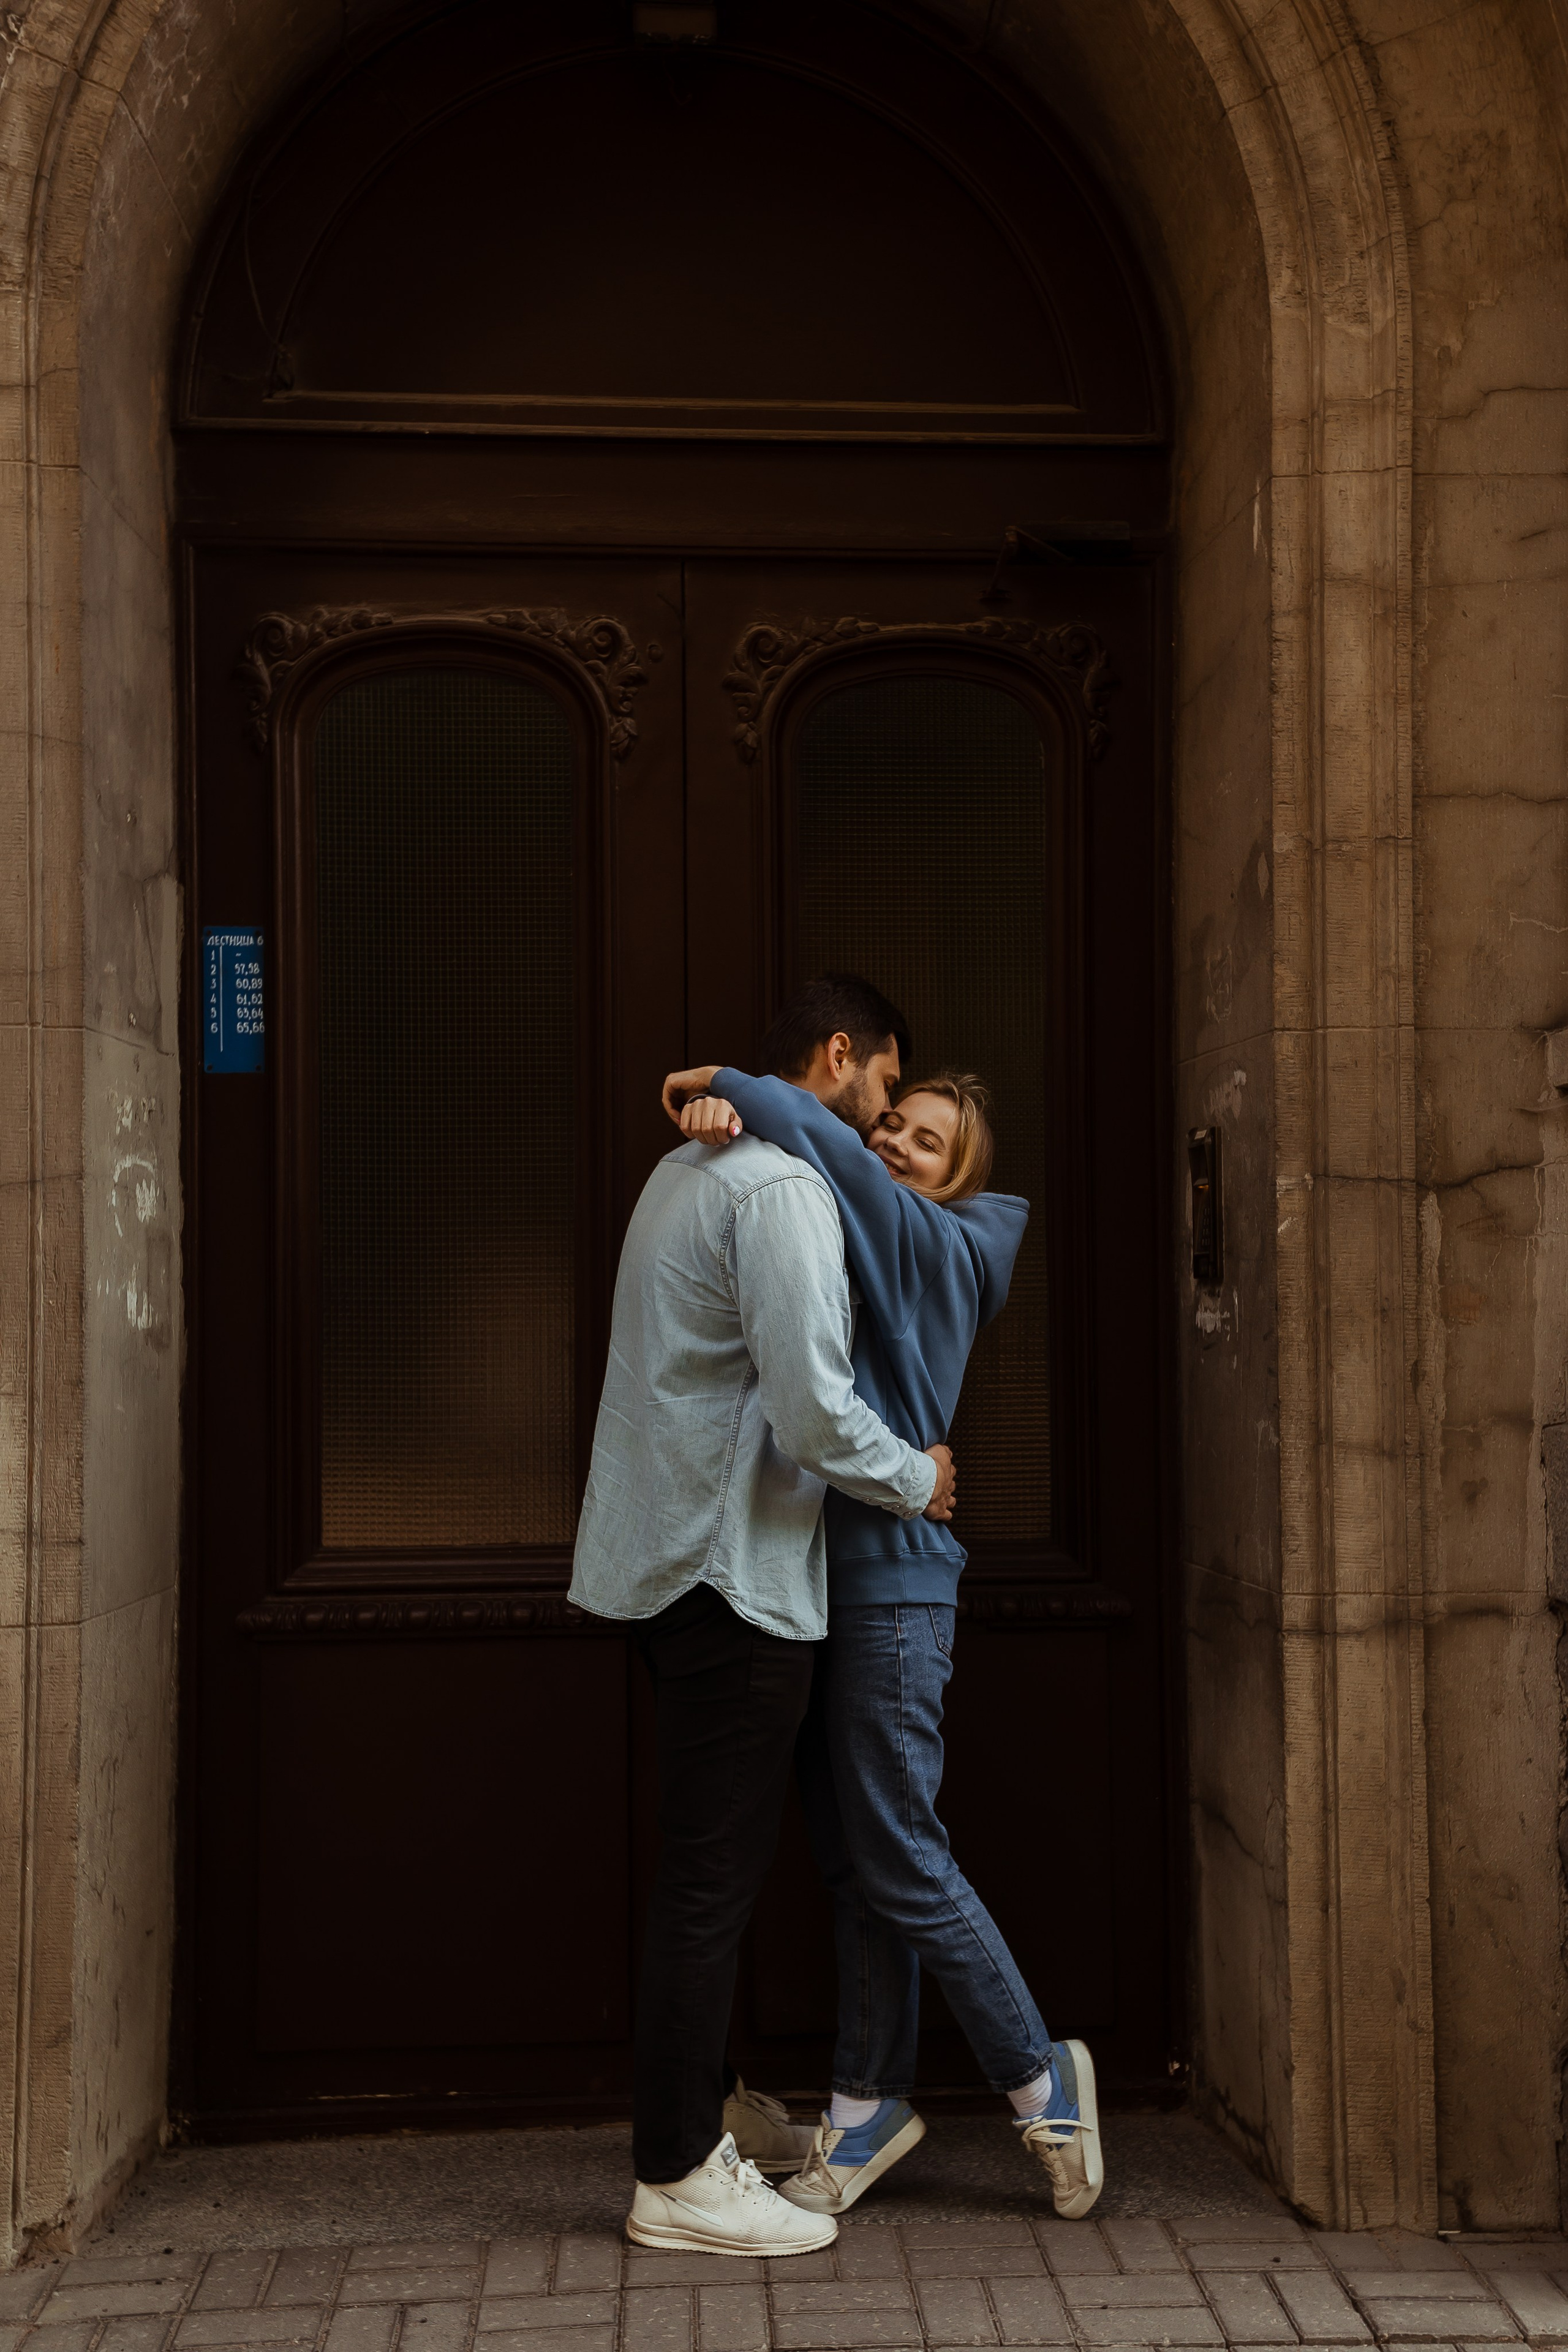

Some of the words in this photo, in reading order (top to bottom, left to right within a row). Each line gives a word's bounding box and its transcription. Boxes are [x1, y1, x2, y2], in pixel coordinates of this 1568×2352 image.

[206, 935, 254, 946] ЛЕСТНИЦА
[211, 949, 215, 961] 1
[210, 964, 216, 975] 2
[235, 963, 260, 975] 57,58
[210, 978, 216, 989] 3
[210, 993, 216, 1004] 4
[211, 1008, 217, 1018] 5
[211, 1022, 217, 1033] 6
